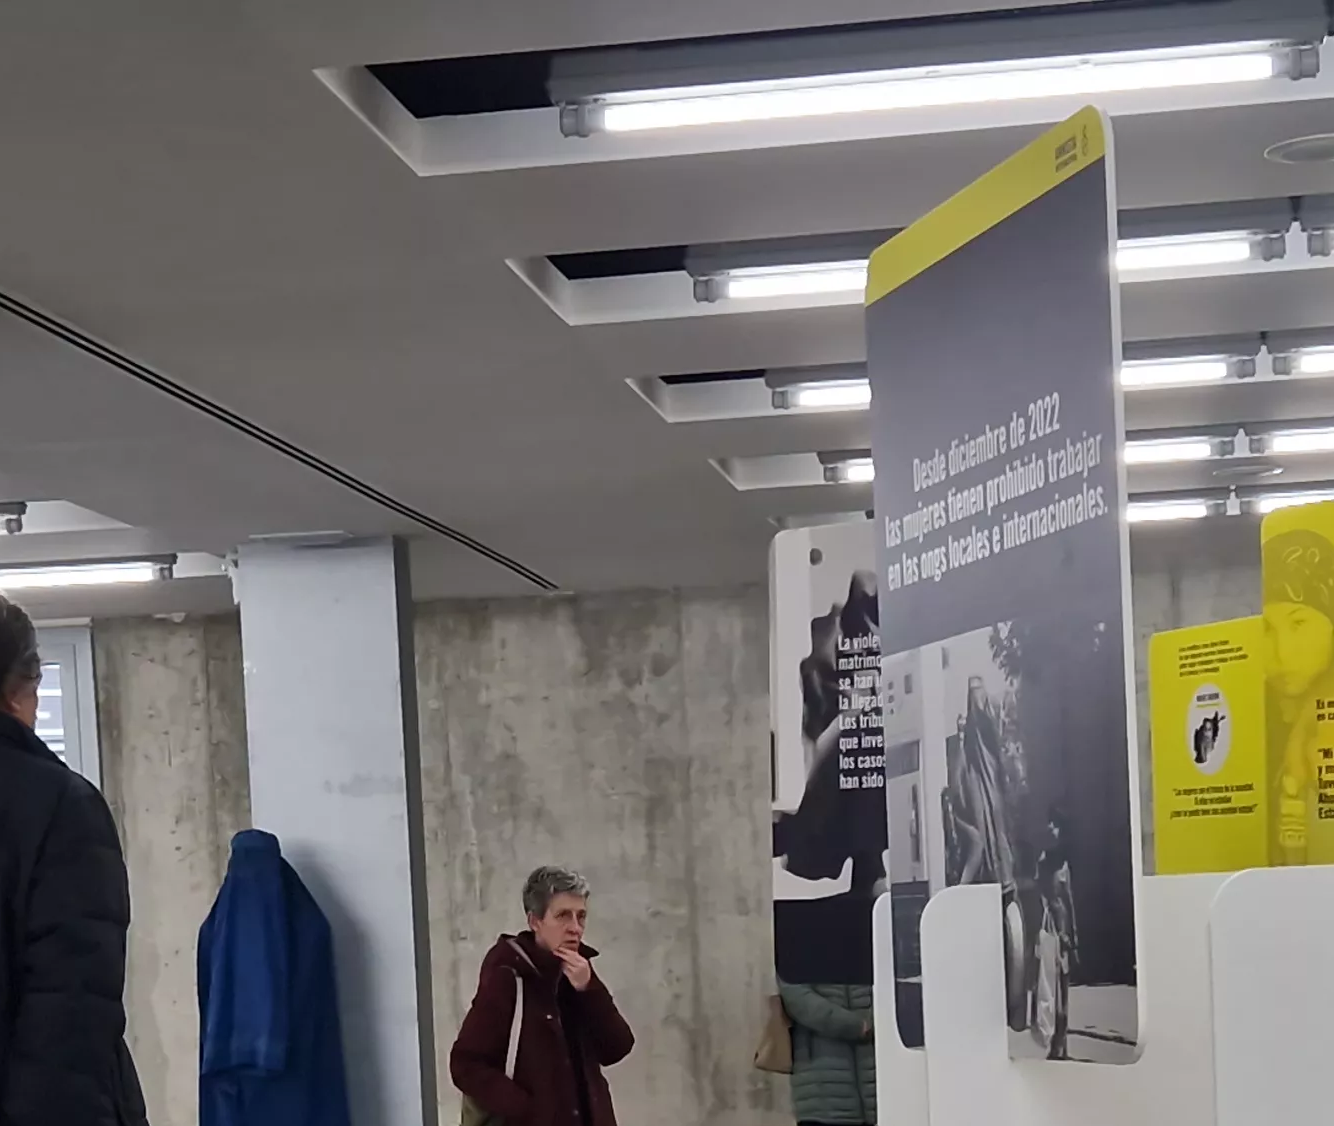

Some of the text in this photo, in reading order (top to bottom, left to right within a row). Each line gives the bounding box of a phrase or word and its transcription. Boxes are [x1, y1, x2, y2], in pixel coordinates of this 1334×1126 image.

[913, 391, 1060, 492] Desde diciembre de 2022
[885, 431, 1102, 547] las mujeres tienen prohibido trabajar
[888, 482, 1108, 591] en las ongs locales e internacionales.
[838, 634, 850, 651] La
[838, 673, 873, 690] se han
[838, 694, 849, 710] la
[839, 714, 857, 731] Los
[839, 736, 858, 753] que
[839, 753, 855, 770] los
[839, 772, 884, 789] han sido
